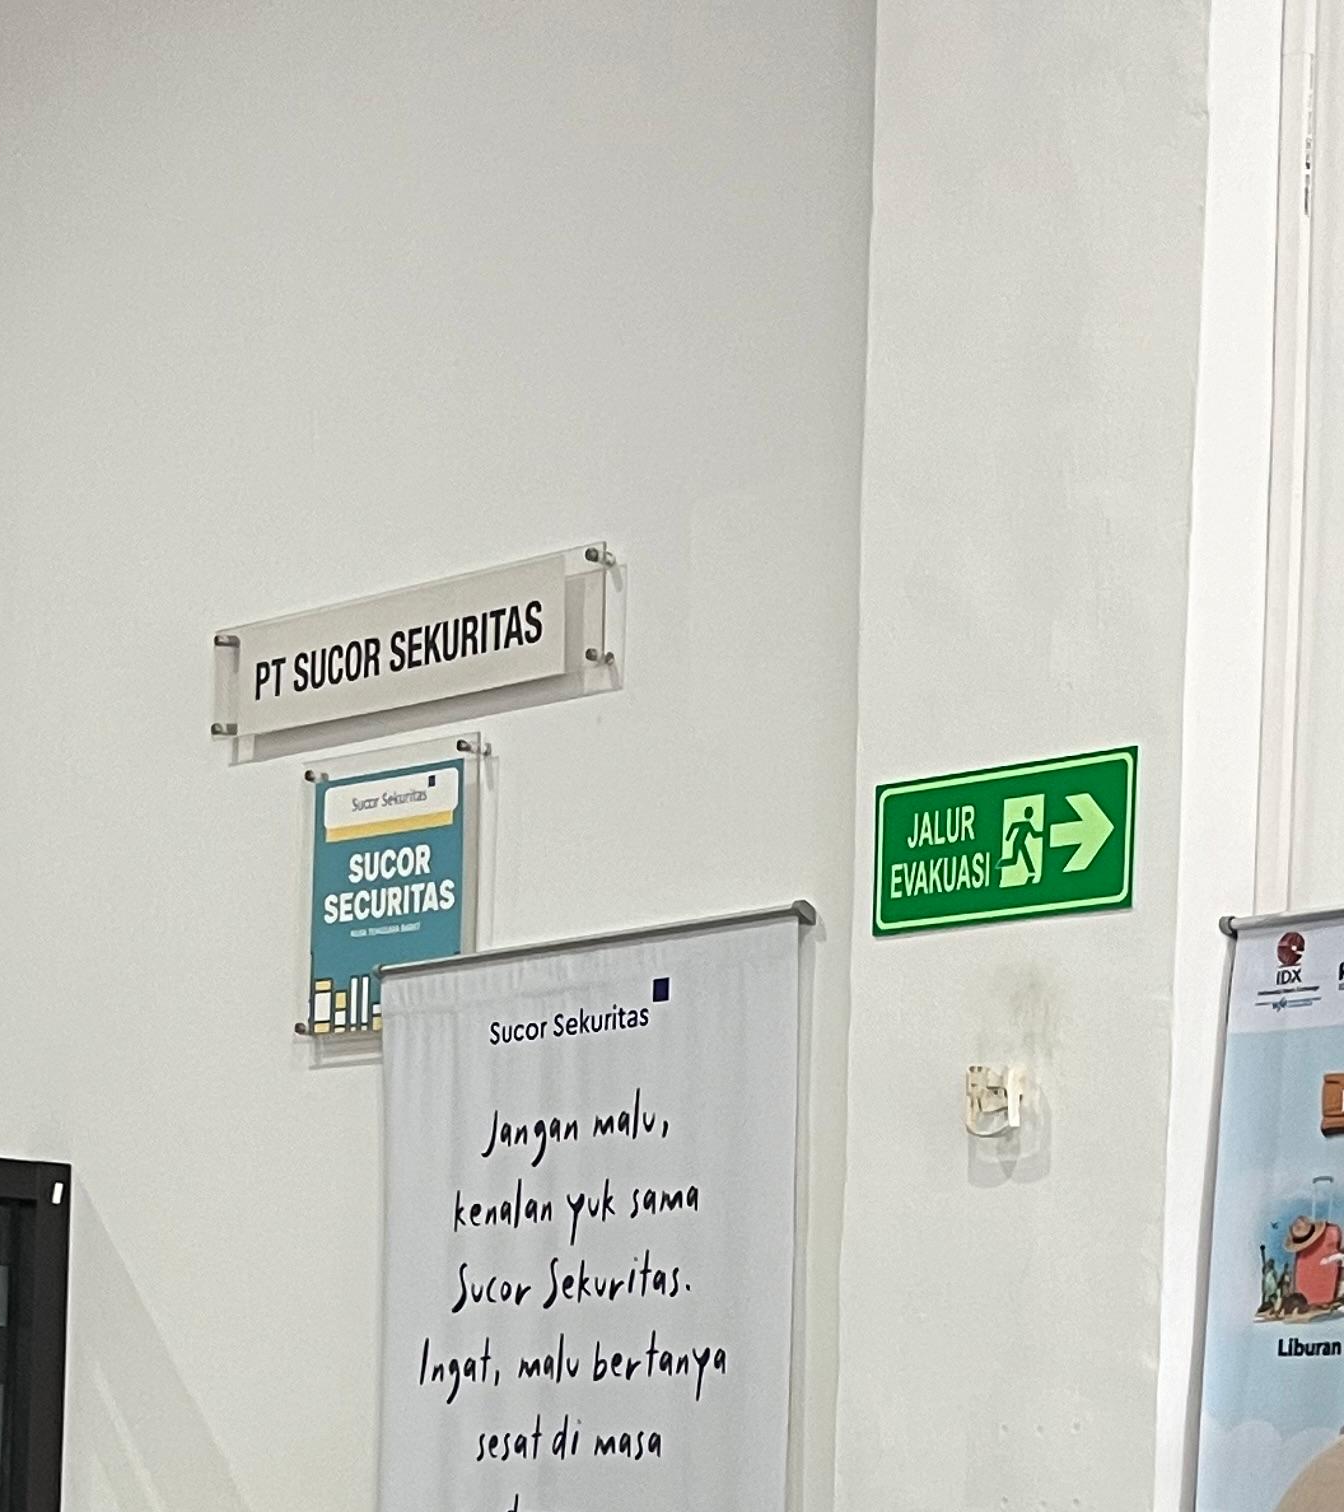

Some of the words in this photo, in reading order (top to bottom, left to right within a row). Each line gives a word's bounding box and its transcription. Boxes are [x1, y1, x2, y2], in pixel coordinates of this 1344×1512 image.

[255, 657, 287, 701] PT
[293, 637, 381, 692] SUCOR
[389, 600, 543, 672] SEKURITAS
[352, 797, 379, 812] Sucor
[381, 789, 427, 807] Sekuritas
[907, 804, 976, 848] JALUR
[348, 844, 431, 884] SUCOR
[890, 852, 990, 899] EVAKUASI
[323, 879, 455, 924] SECURITAS
[1276, 968, 1302, 985] IDX
[490, 1014, 548, 1046] Sucor
[553, 1004, 650, 1038] Sekuritas
[481, 1109, 578, 1166] Jangan
[592, 1088, 669, 1140] malu,
[454, 1179, 552, 1232] kenalan
[568, 1179, 616, 1245] yuk
[630, 1183, 700, 1219] sama
[452, 1261, 531, 1313] Sucor
[543, 1249, 691, 1310] Sekuritas.
[419, 1337, 500, 1404] Ingat,
[517, 1333, 579, 1381] malu
[592, 1330, 727, 1401] bertanya
[1277, 1337, 1343, 1358] Liburan
[476, 1414, 542, 1463] sesat
[551, 1413, 582, 1456] di
[593, 1429, 662, 1461] masa
